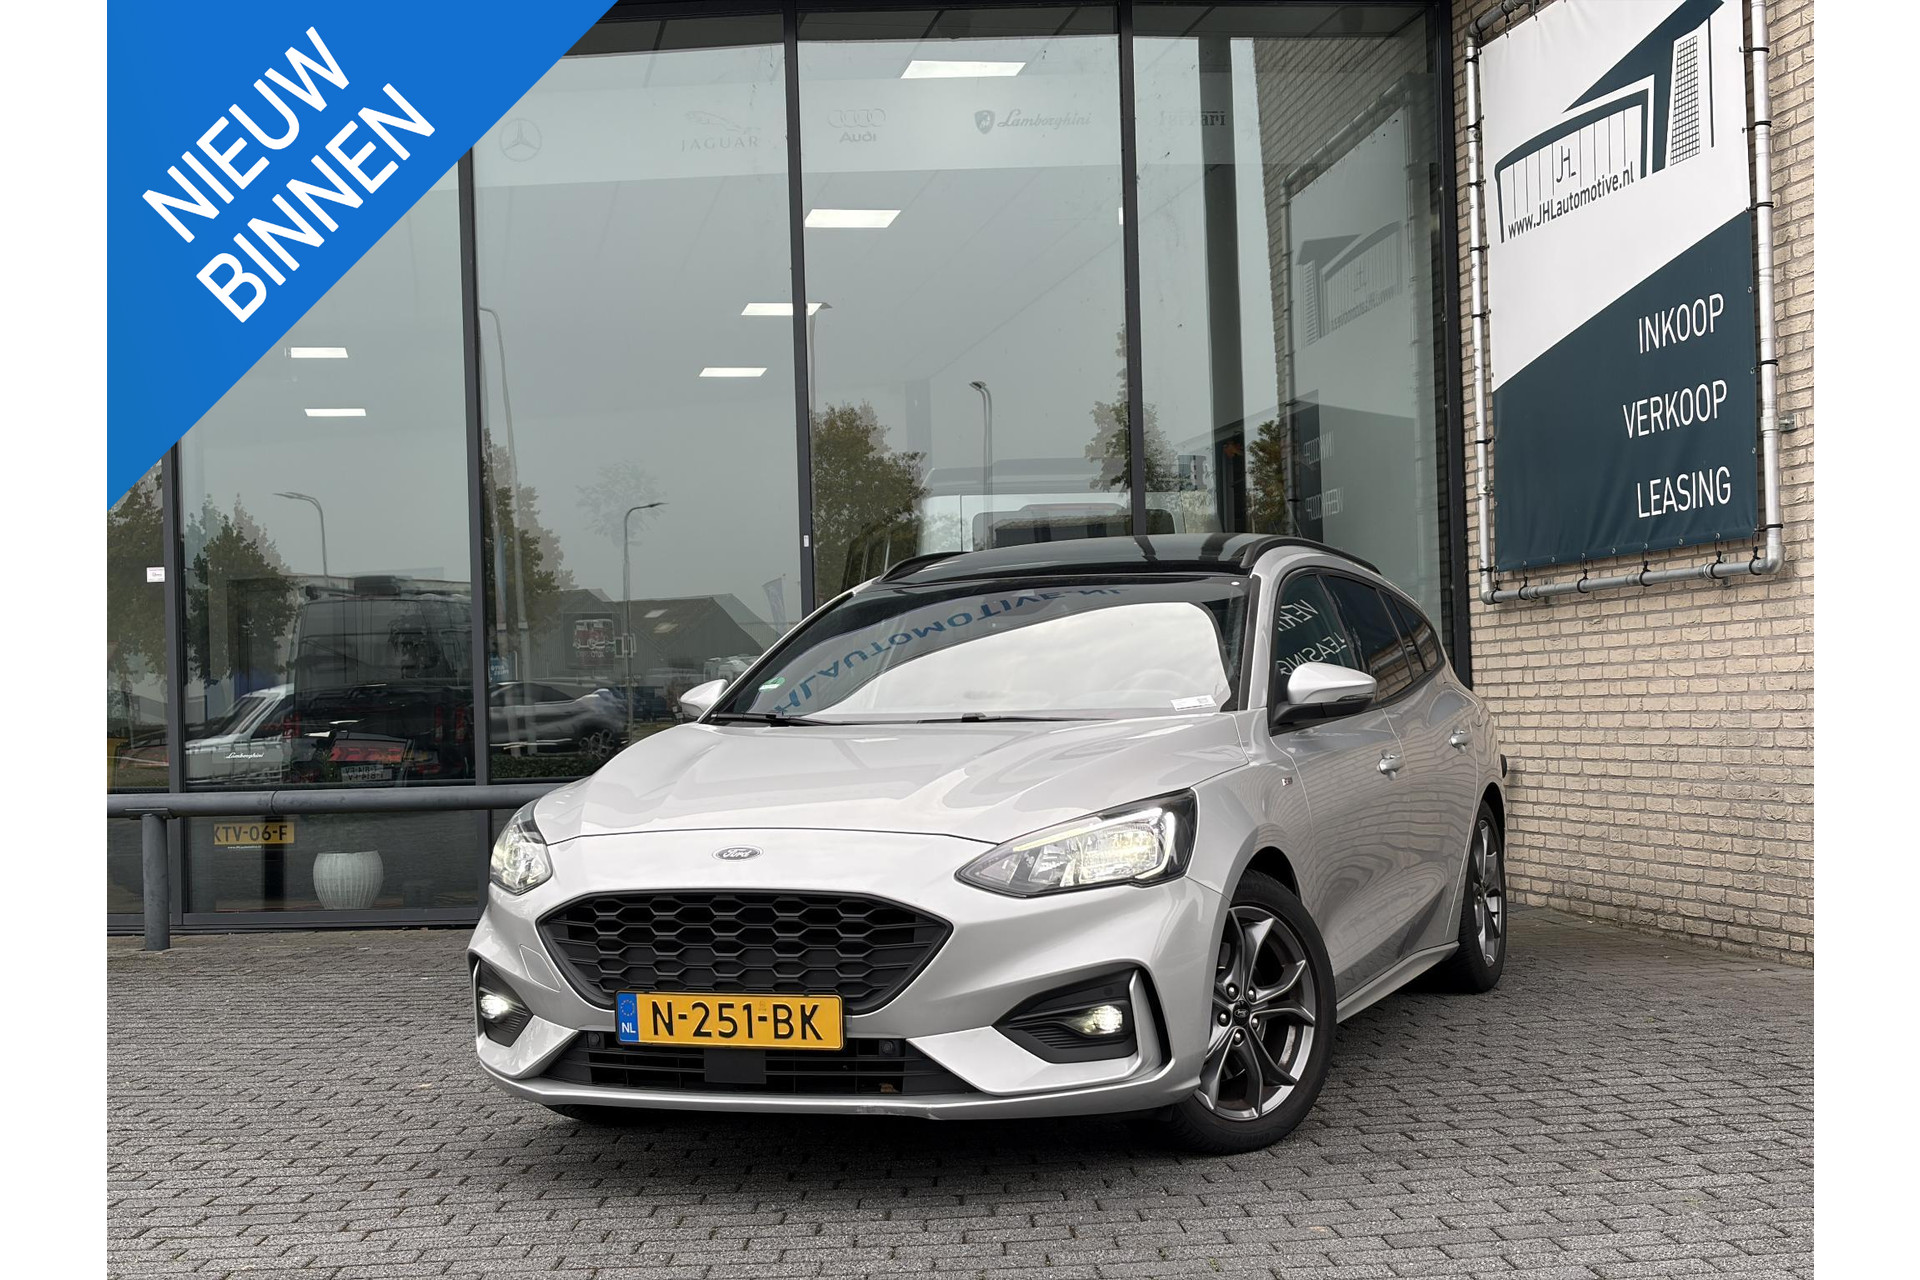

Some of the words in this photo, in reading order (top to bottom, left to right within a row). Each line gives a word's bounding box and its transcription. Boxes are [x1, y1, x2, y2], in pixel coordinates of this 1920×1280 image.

[839, 131, 877, 143] Audi
[997, 108, 1093, 130] Lamborghini
[682, 135, 758, 152] JAGUAR
[1508, 161, 1635, 239] www.JHLautomotive.nl
[1638, 293, 1725, 354] INKOOP
[1622, 379, 1728, 439] VERKOOP
[1636, 466, 1732, 519] LEASING
[621, 1022, 636, 1034] NL
[652, 1001, 823, 1041] N-251-BK
